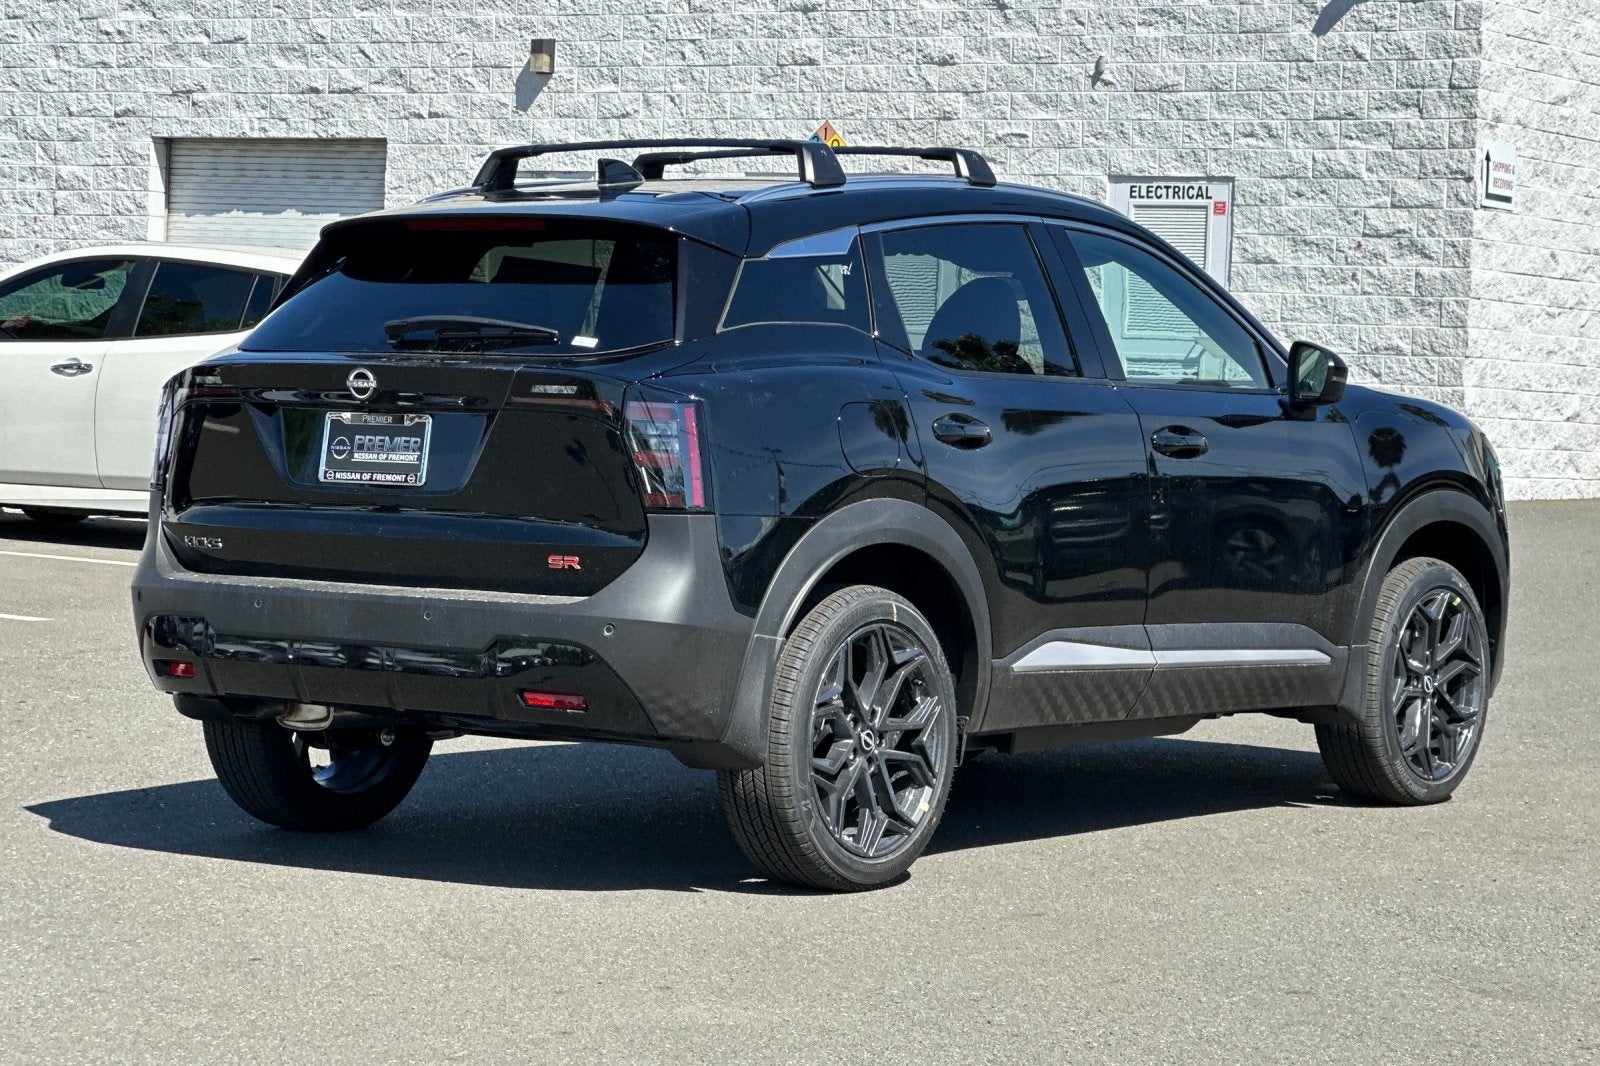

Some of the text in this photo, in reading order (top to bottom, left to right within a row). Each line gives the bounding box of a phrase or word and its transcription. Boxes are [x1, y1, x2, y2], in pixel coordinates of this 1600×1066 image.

[1129, 185, 1213, 200] ELECTRICAL
[347, 380, 376, 388] NISSAN
[362, 414, 393, 424] PREMIER
[354, 435, 421, 452] PREMIER
[353, 452, 377, 460] NISSAN
[388, 453, 419, 462] FREMONT
[335, 471, 407, 483] NISSAN OF FREMONT
[184, 535, 223, 549] KICKS
[548, 555, 582, 569] SR
